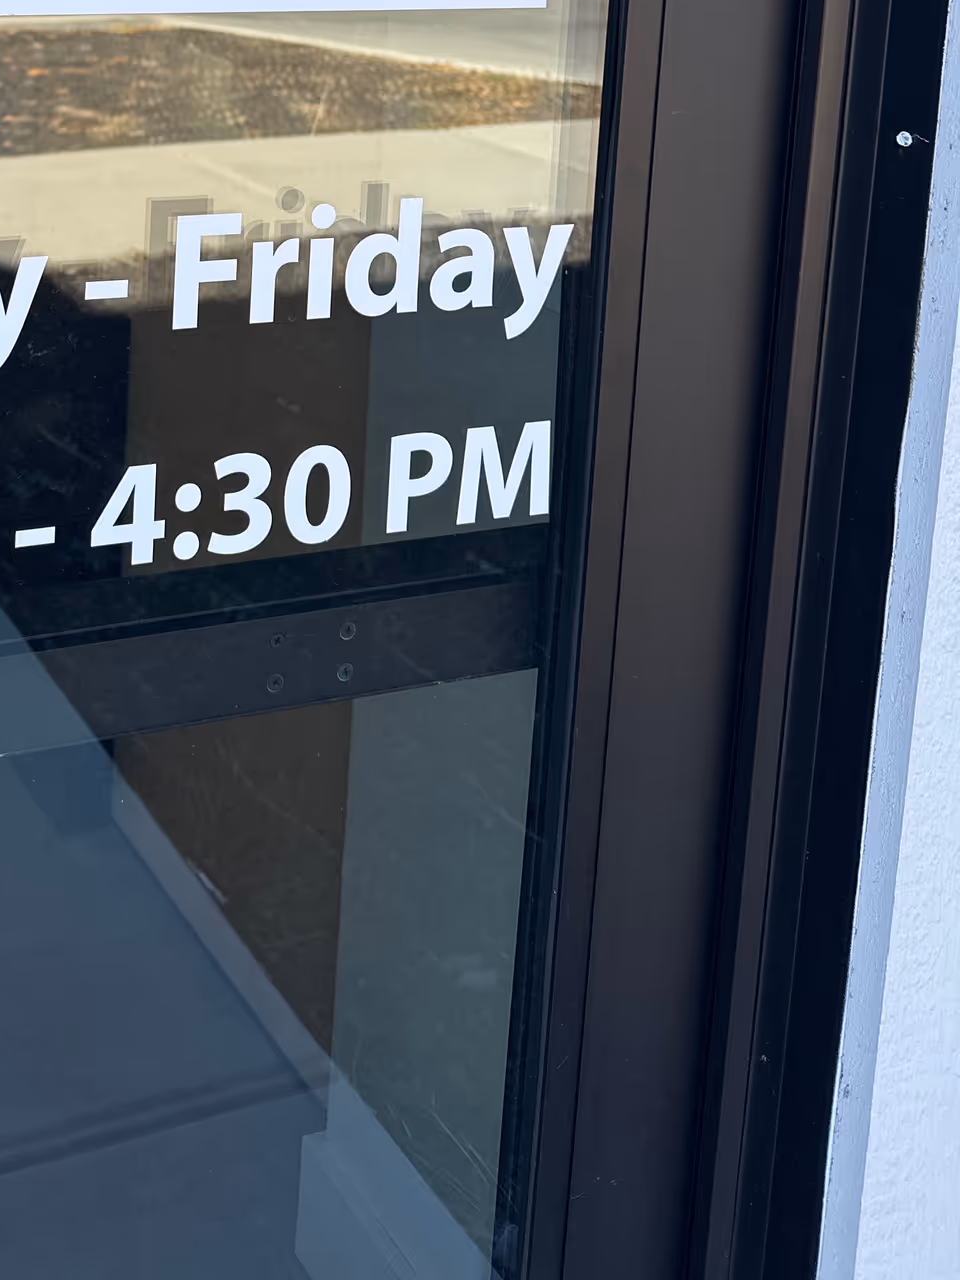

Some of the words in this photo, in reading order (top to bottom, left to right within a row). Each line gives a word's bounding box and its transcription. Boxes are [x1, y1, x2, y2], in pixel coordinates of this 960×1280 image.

[84, 279, 129, 301] -
[172, 197, 575, 340] Friday
[14, 526, 56, 549] -
[90, 444, 352, 566] 4:30
[385, 420, 552, 535] PM
